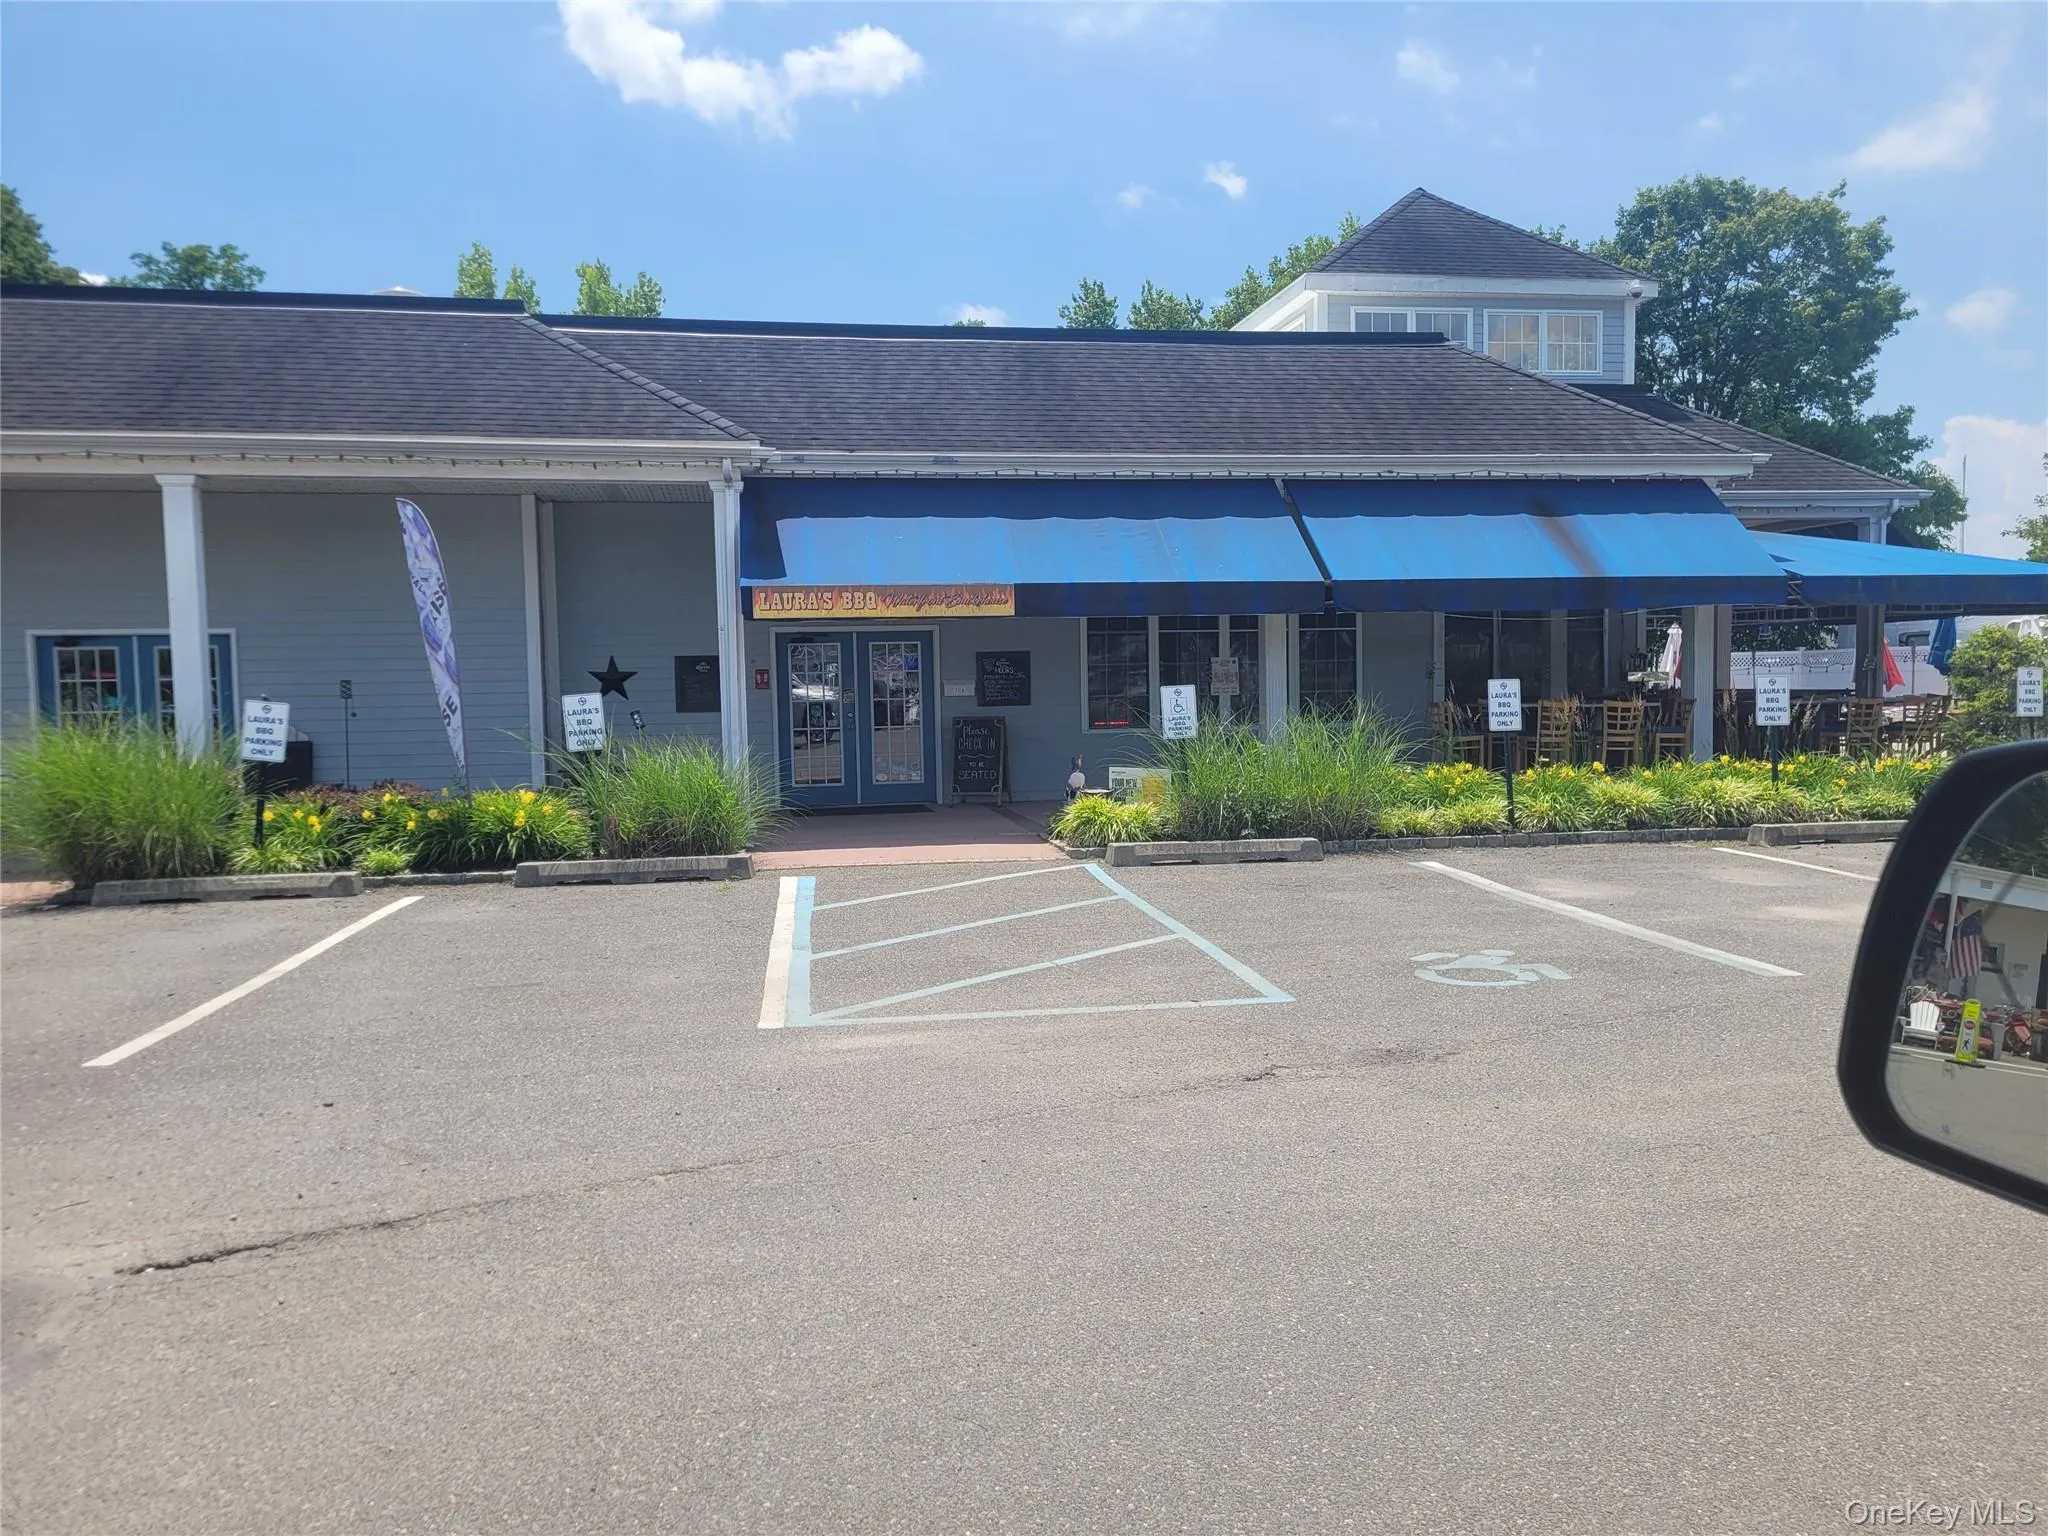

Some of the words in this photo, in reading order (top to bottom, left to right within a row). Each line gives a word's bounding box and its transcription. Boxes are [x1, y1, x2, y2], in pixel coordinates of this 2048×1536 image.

[759, 592, 834, 611] LAURA'S
[841, 591, 877, 611] BBQ
[1490, 691, 1518, 699] LAURA'S
[1757, 687, 1787, 695] LAURA'S
[566, 707, 600, 716] LAURA'S
[1490, 710, 1519, 718] PARKING
[576, 718, 593, 726] BBQ
[1764, 714, 1782, 722] ONLY
[1496, 719, 1514, 727] ONLY
[568, 728, 603, 737] PARKING
[576, 739, 597, 747] ONLY
[958, 737, 983, 750] CHECK
[987, 737, 996, 750] IN
[958, 769, 997, 780] SEATED
[1111, 777, 1125, 788] YOUR
